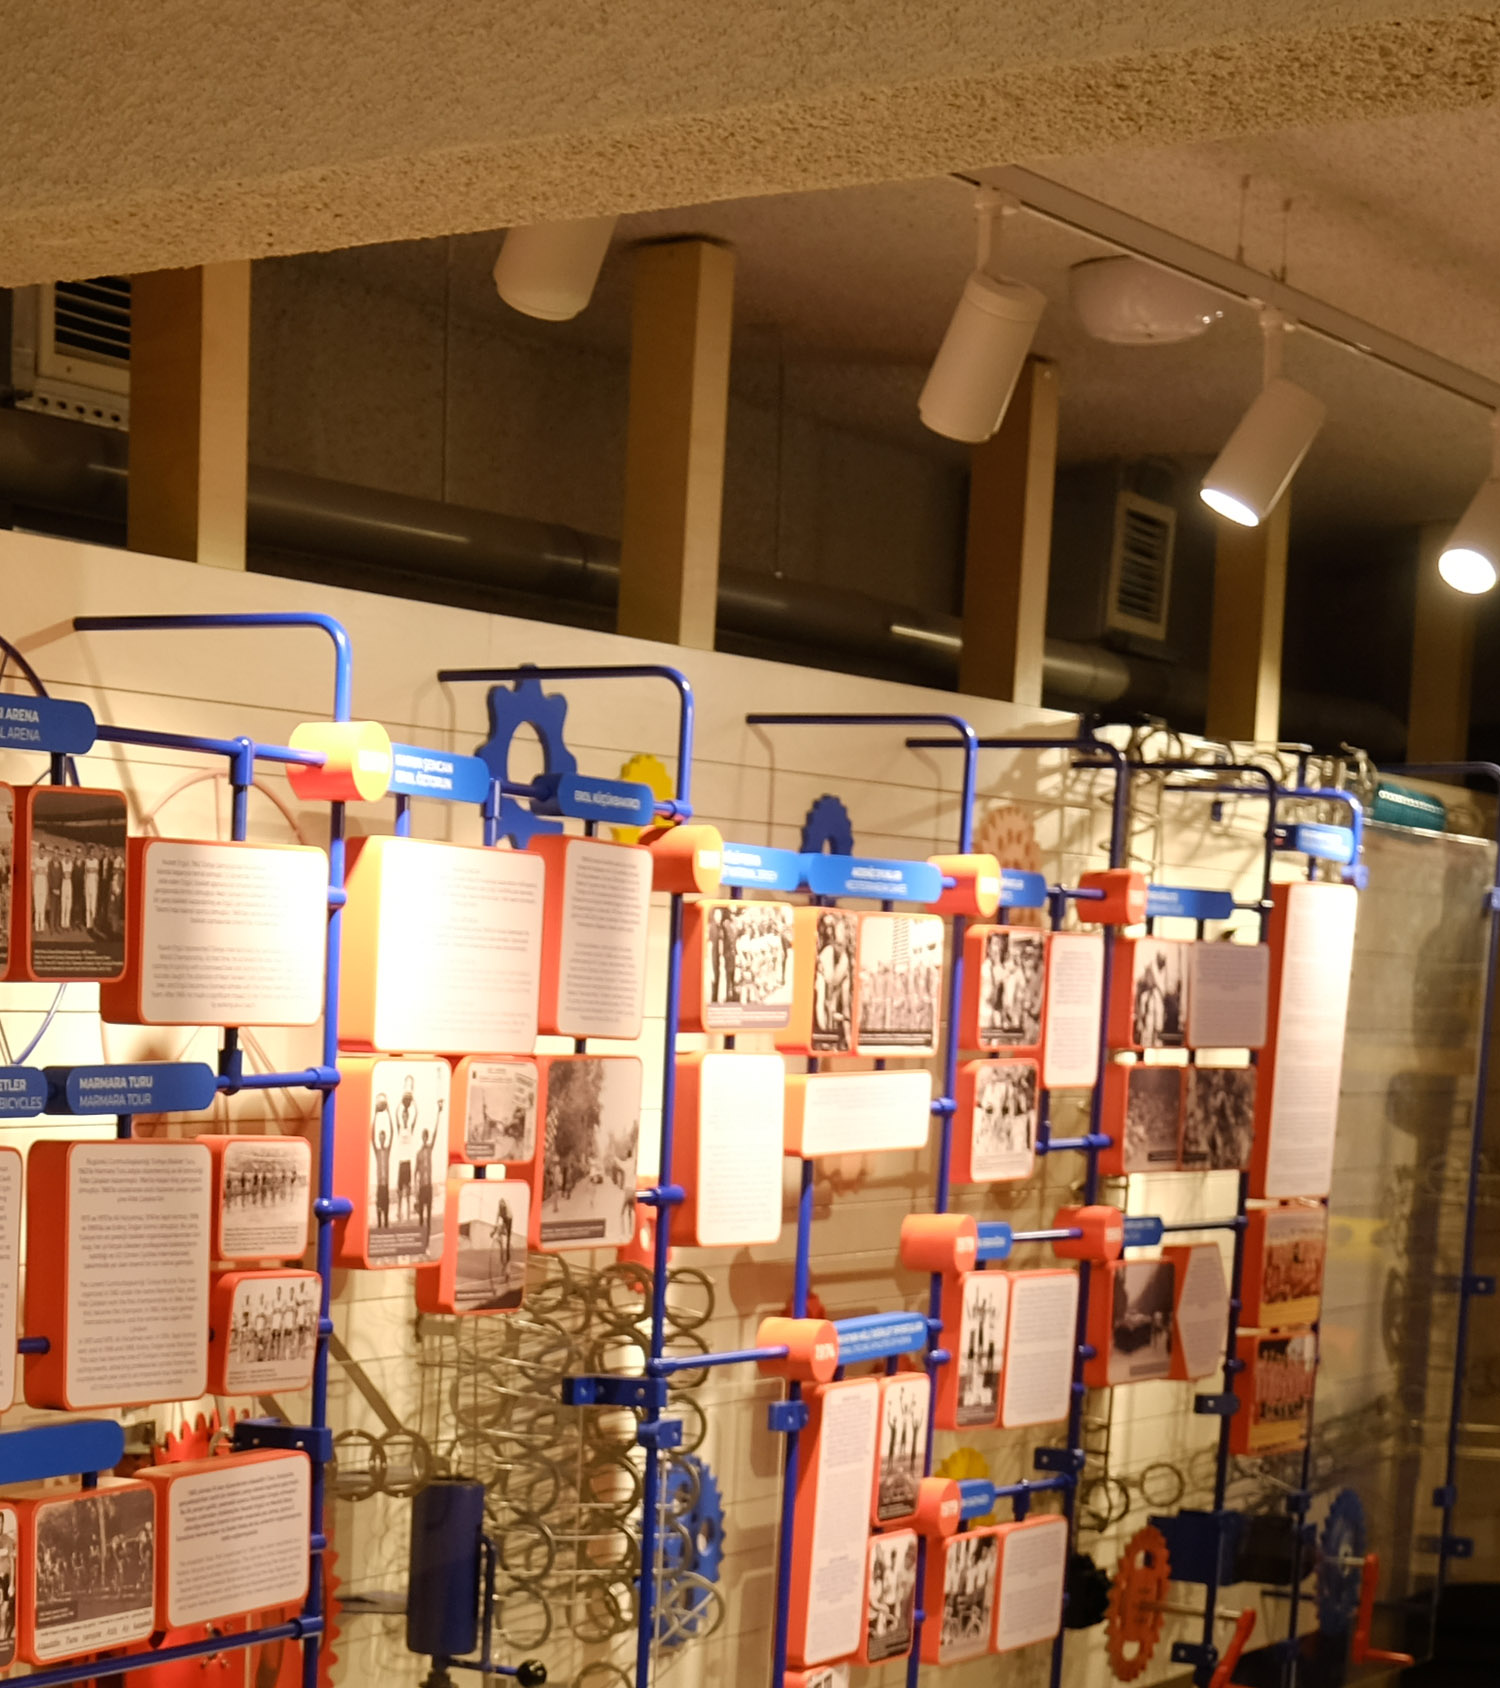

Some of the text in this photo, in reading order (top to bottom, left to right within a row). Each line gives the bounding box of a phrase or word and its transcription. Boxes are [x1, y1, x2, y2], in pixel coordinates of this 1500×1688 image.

[5, 706, 40, 723] ARENA
[7, 727, 40, 741] ARENA
[79, 1075, 153, 1090] MARMARA TURU
[0, 1095, 43, 1109] BICYCLES
[79, 1092, 152, 1107] MARMARA TOUR
